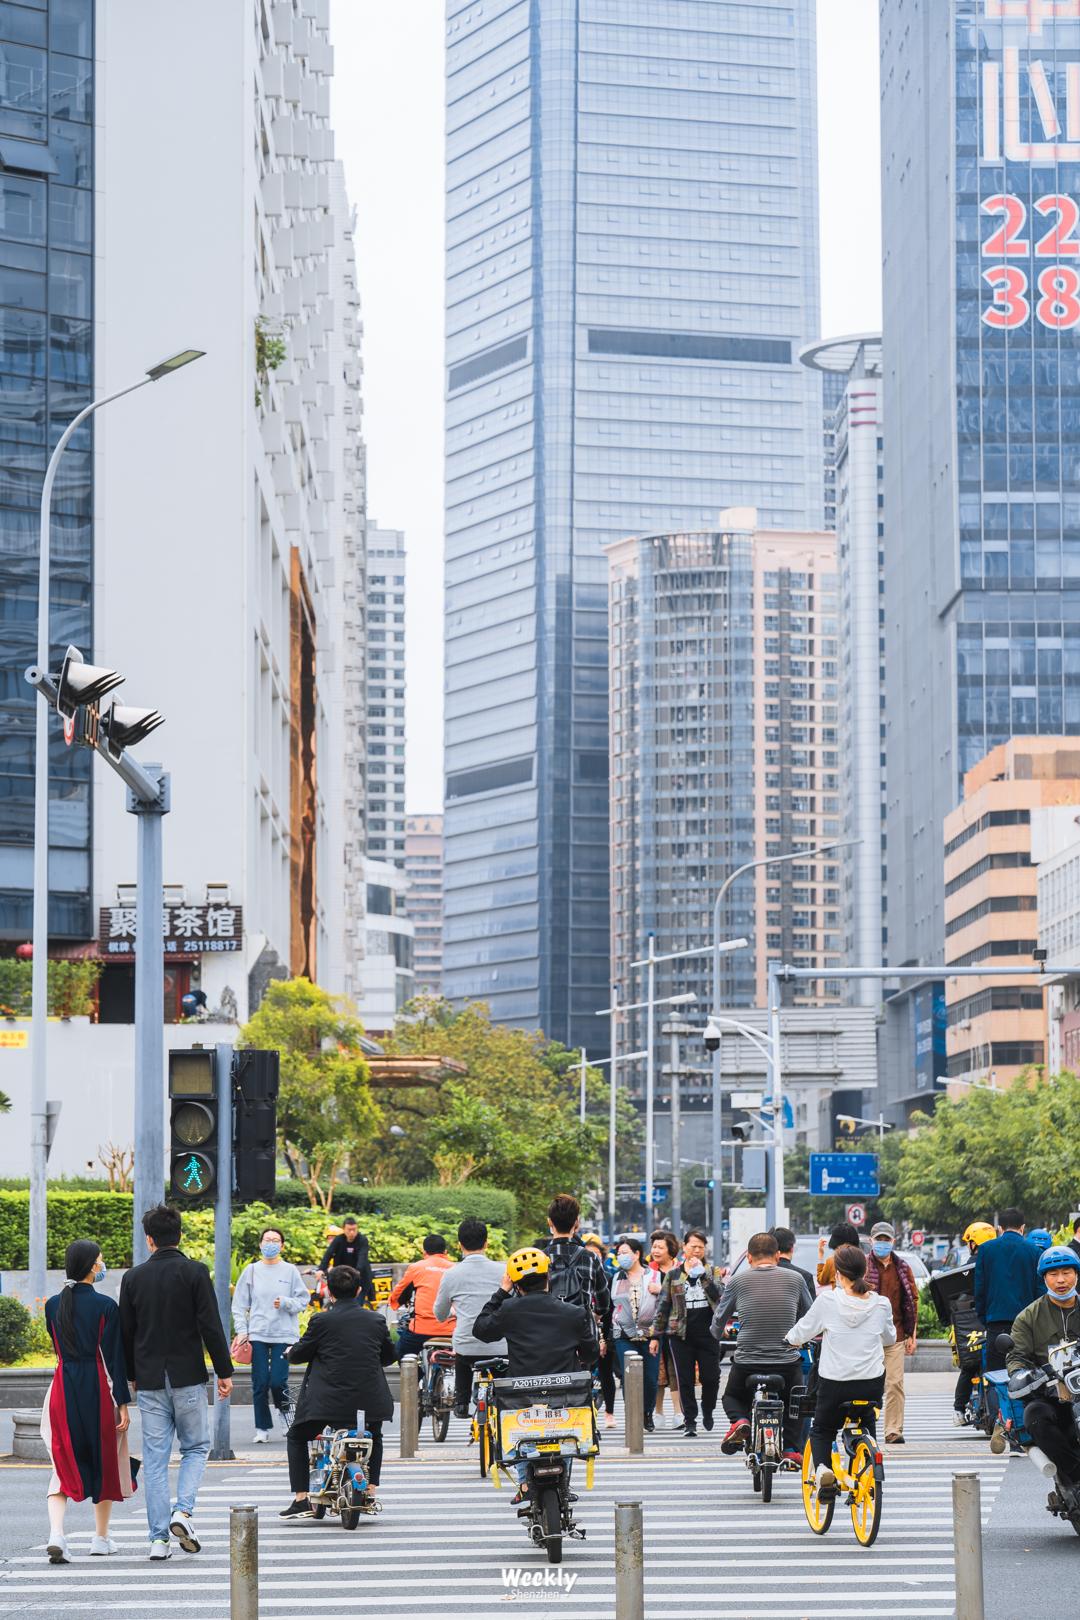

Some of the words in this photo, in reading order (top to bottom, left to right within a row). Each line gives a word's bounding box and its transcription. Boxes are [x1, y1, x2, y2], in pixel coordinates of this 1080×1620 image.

[980, 193, 1080, 258] 22
[981, 264, 1080, 330] 38
[184, 941, 237, 951] 25118817
